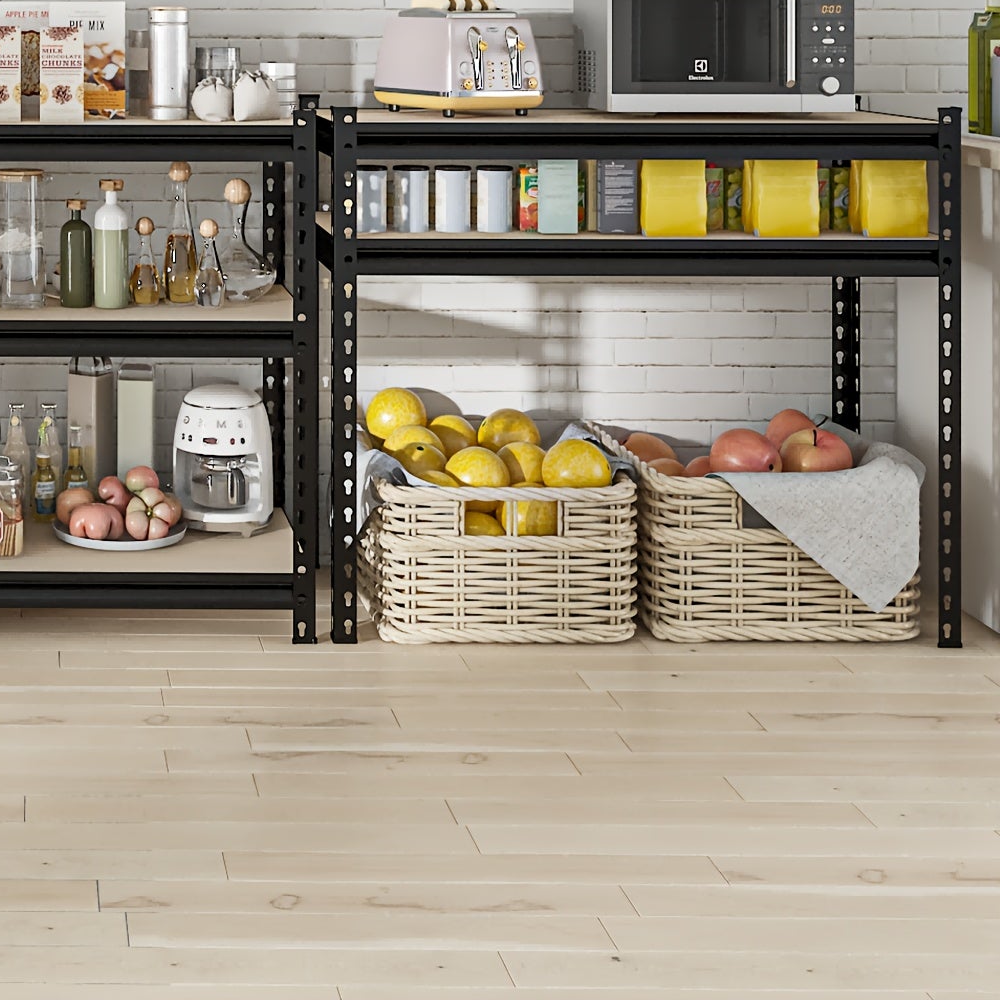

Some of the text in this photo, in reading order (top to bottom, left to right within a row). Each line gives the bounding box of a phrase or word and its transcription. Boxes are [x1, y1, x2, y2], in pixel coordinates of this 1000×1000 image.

[5, 10, 25, 18] APPLE
[29, 10, 38, 18] PIE
[88, 20, 105, 31] MIX
